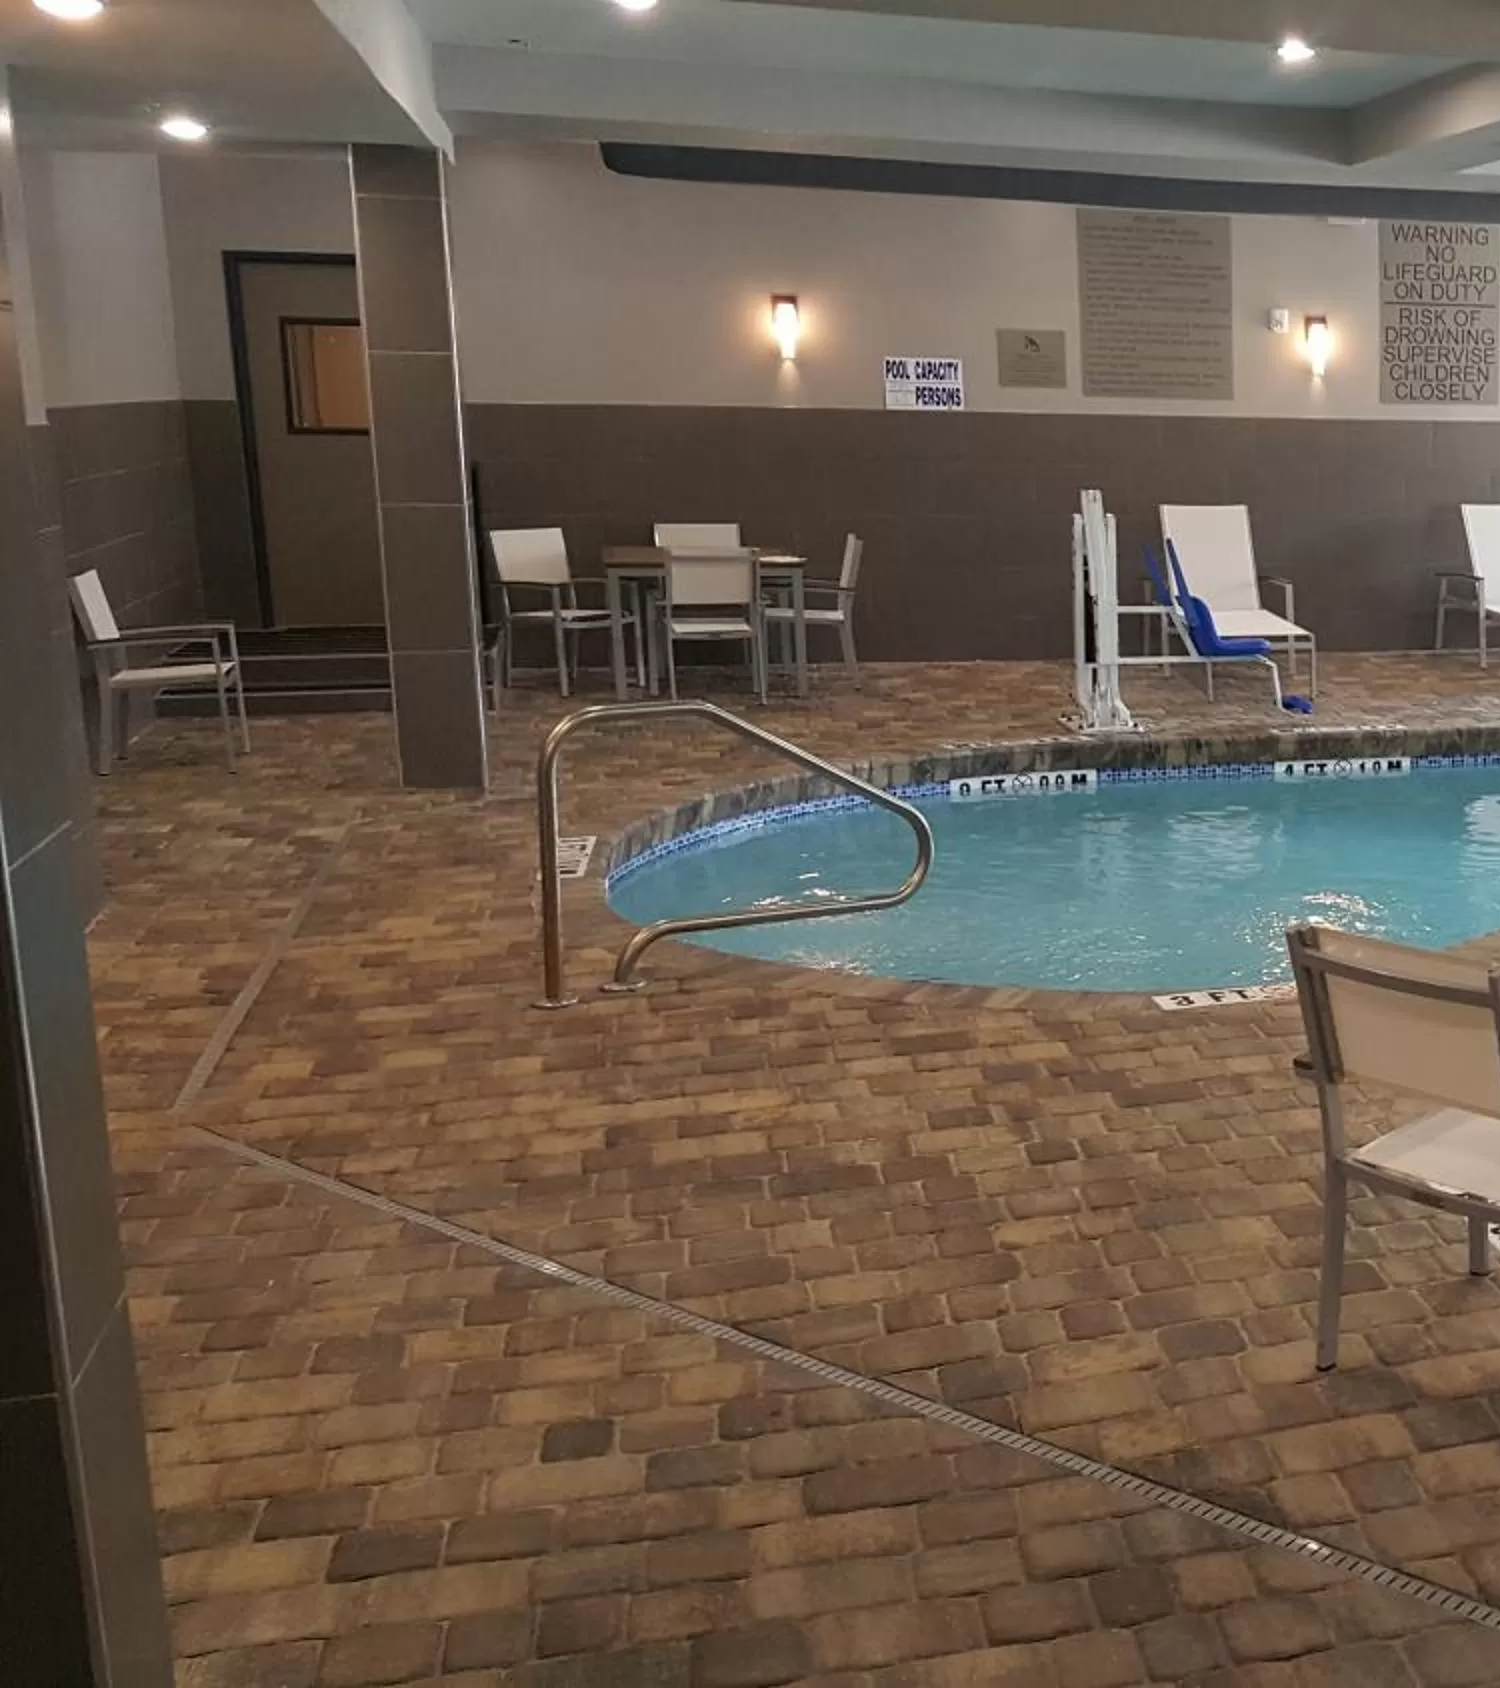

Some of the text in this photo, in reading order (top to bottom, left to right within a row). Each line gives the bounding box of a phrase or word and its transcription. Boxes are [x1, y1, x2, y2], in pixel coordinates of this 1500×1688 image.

[1391, 223, 1490, 246] WARNING
[1426, 245, 1456, 263] NO
[1383, 263, 1497, 284] LIFEGUARD
[1394, 282, 1487, 302] ON DUTY
[1399, 307, 1481, 328] RISK OF
[1384, 326, 1495, 346] DROWNING
[1383, 346, 1497, 365] SUPERVISE
[885, 359, 959, 381] POOL CAPACITY
[1389, 364, 1490, 383] CHILDREN
[915, 386, 962, 406] PERSONS
[1394, 382, 1486, 401] CLOSELY
